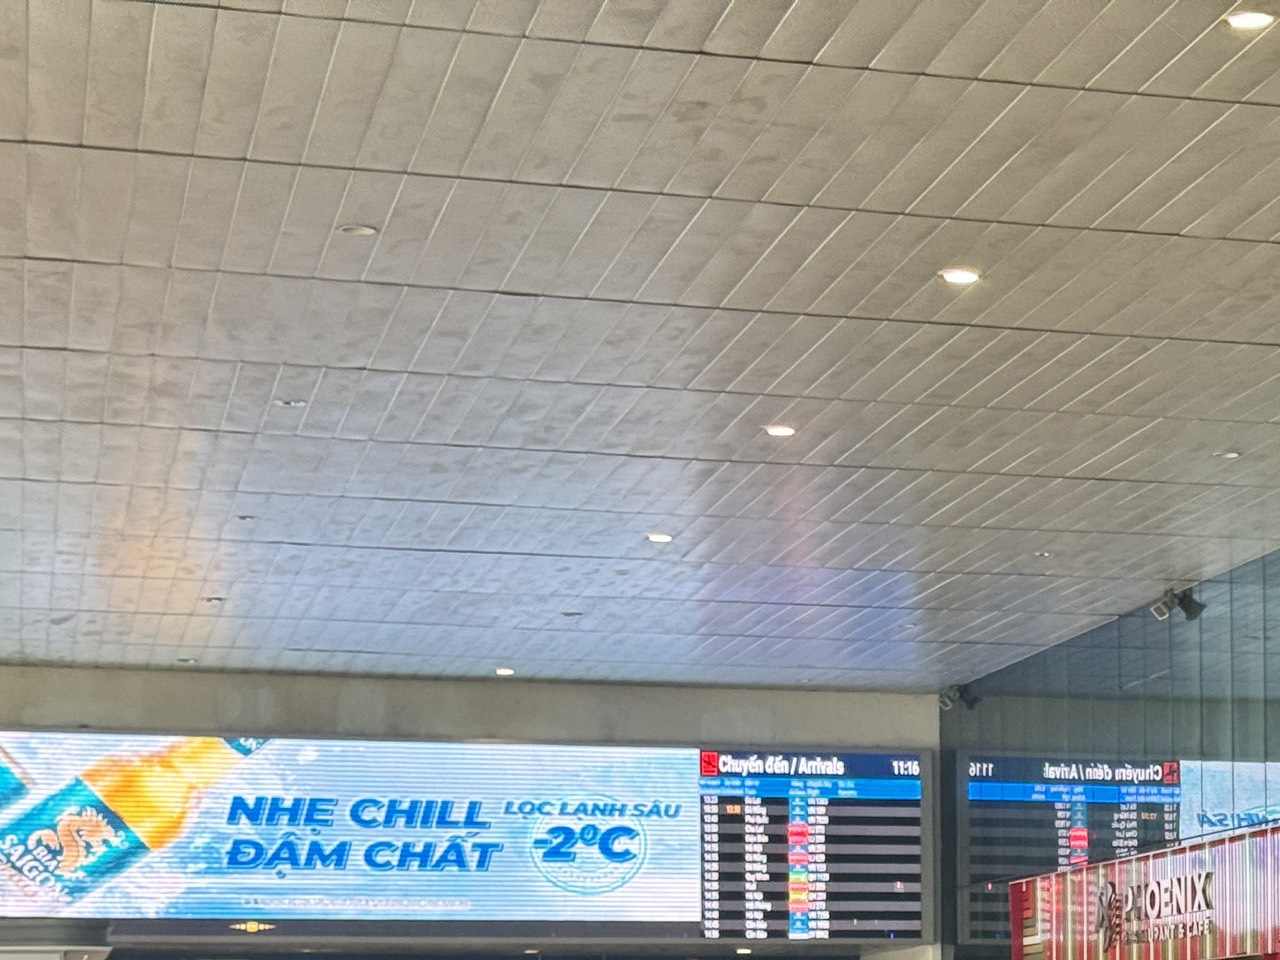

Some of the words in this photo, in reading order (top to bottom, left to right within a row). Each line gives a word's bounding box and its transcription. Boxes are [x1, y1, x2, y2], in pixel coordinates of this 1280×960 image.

[718, 755, 764, 777] Chuyến
[765, 756, 789, 774] đến
[799, 757, 845, 775] Arrivals
[892, 760, 920, 776] 11:16
[227, 796, 339, 835] NHẸ
[350, 798, 491, 828] CHILL
[503, 801, 554, 819] LỌC
[558, 802, 628, 820] LẠNH
[631, 800, 682, 818] SÂU
[225, 832, 352, 878] ĐẬM
[363, 831, 503, 872] CHẤT
[1122, 871, 1214, 921] PHOENIX
